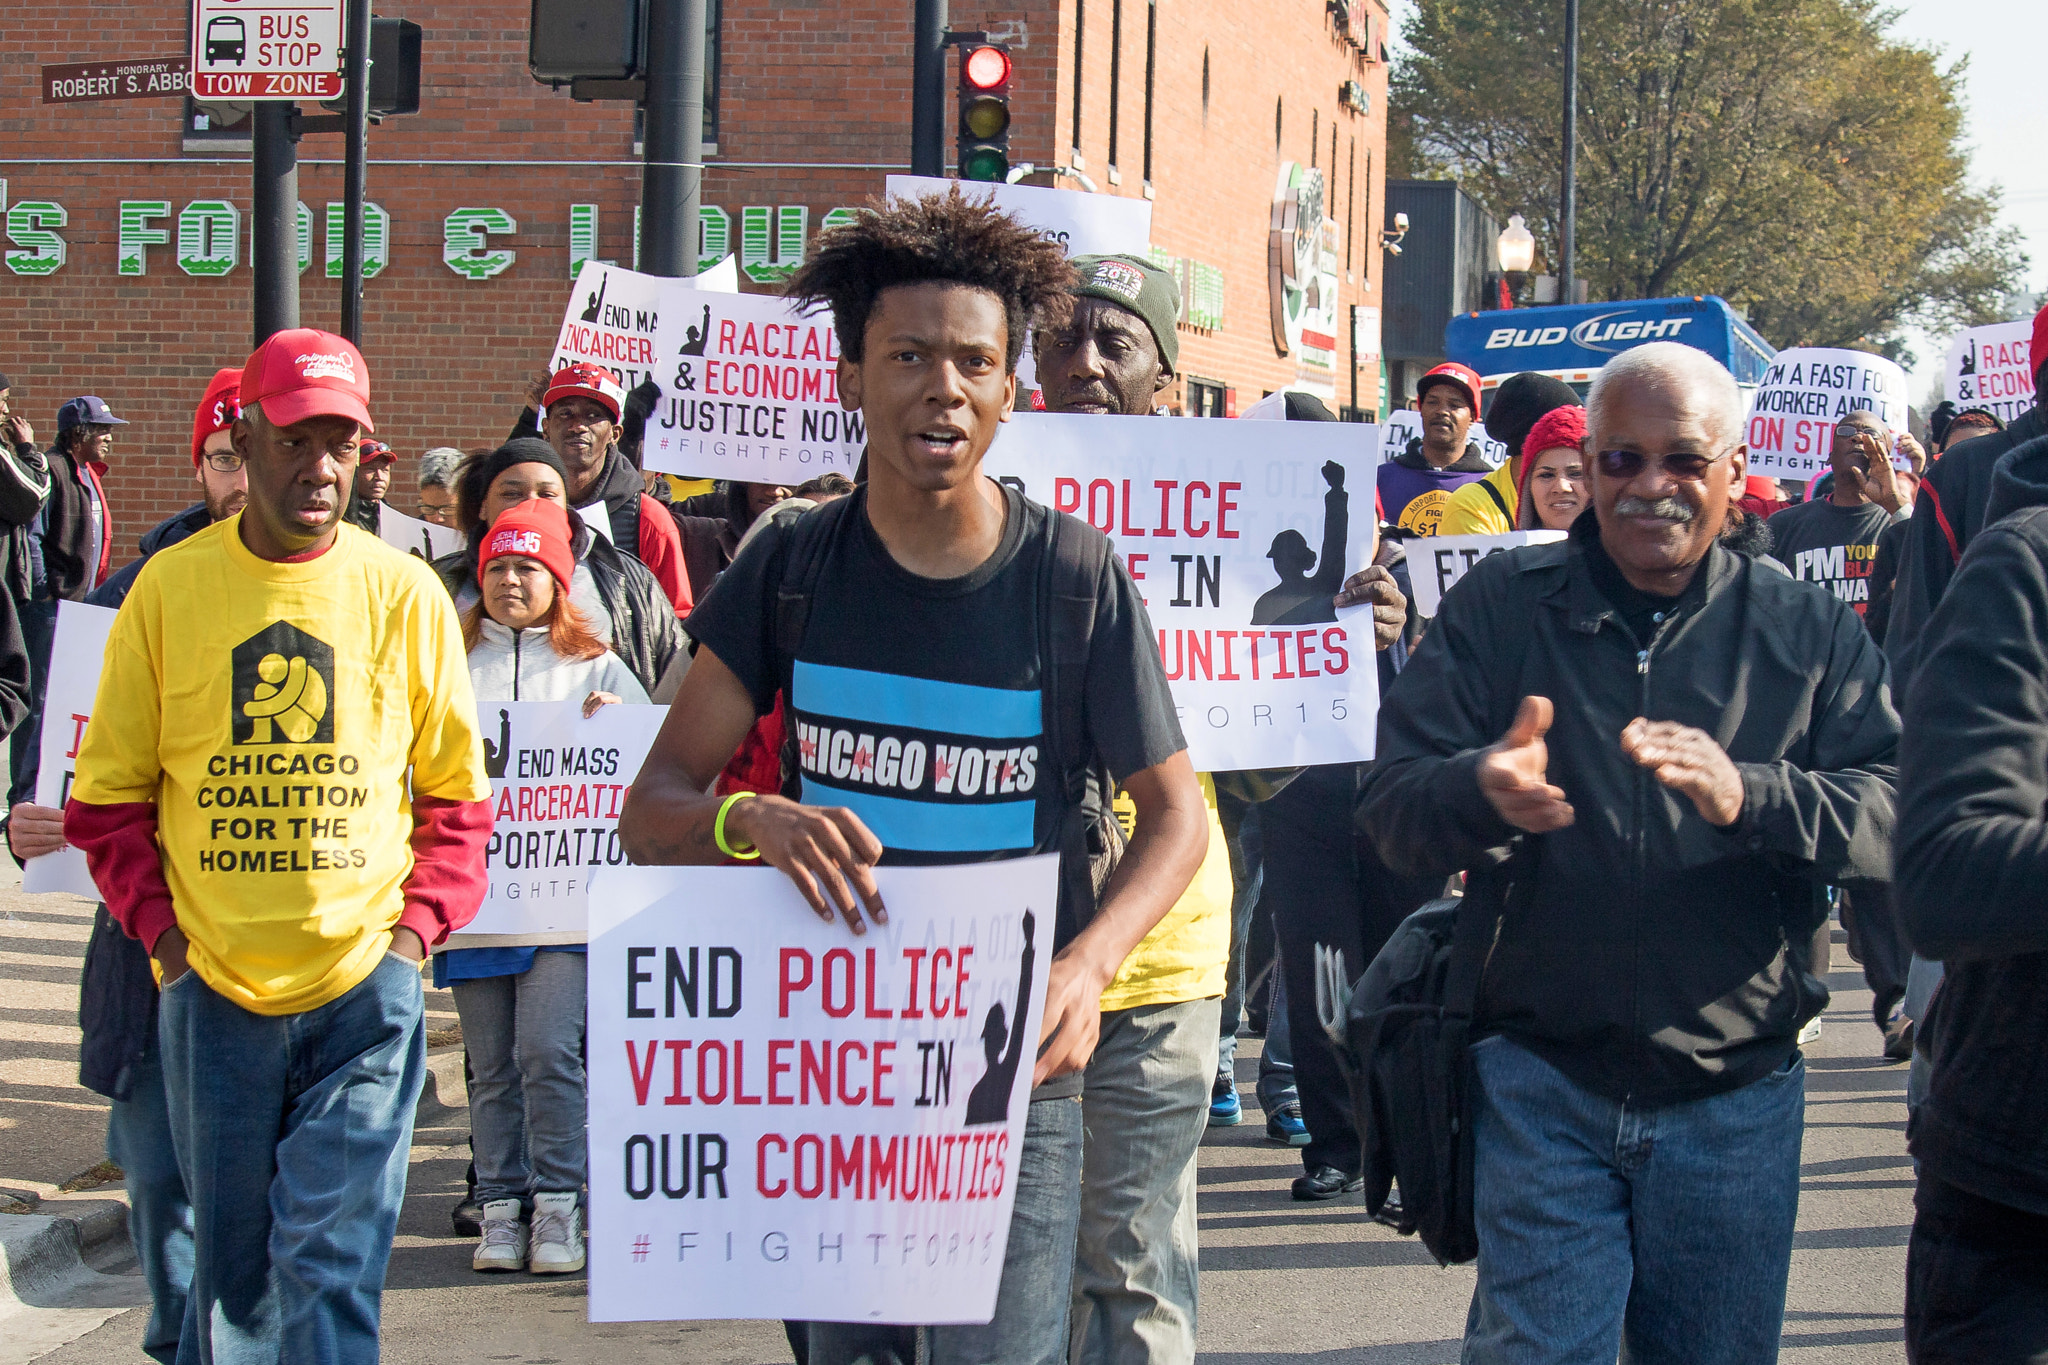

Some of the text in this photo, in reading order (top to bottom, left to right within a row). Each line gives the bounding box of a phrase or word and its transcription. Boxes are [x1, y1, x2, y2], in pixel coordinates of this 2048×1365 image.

[260, 15, 309, 38] BUS
[116, 64, 169, 75] HONORARY
[258, 43, 321, 66] STOP
[52, 76, 120, 98] ROBERT
[126, 75, 141, 93] S.
[203, 75, 328, 94] TOW ZONE
[0, 179, 67, 276] S
[118, 200, 390, 278] FOD
[604, 304, 630, 329] END
[562, 323, 658, 364] INCARCER
[719, 319, 838, 362] RACIAL
[1485, 318, 1692, 349] BUD LIGHT
[674, 360, 839, 404] & ECONOMI
[1760, 363, 1786, 388] I'M
[1789, 363, 1803, 386] A
[1809, 363, 1857, 390] FAST
[1959, 370, 2036, 400] & ECON
[1756, 390, 1829, 418] WORKER
[1834, 395, 1873, 418] AND
[661, 398, 787, 440] JUSTICE
[802, 409, 866, 444] NOW
[1749, 416, 1839, 456] ON ST
[1055, 477, 1242, 539] POLICE
[1409, 493, 1437, 514] AIRPORT
[521, 531, 542, 553] 15
[1795, 545, 1845, 582] I'M
[1170, 554, 1220, 608] IN
[1177, 698, 1348, 730] OR15
[208, 754, 359, 777] CHICAGO
[518, 747, 620, 778] END MASS
[795, 717, 1038, 796] HICAGO VOTES
[197, 785, 368, 809] COALITION
[490, 783, 631, 822] ARCERATI
[211, 818, 348, 840] FOR THE
[200, 849, 366, 873] HOMELESS
[485, 828, 632, 869] PORTATIO
[490, 879, 589, 900] IGHTF
[626, 946, 974, 1019] END POLICE
[625, 1039, 954, 1107] VIOLENCE IN
[624, 1133, 1009, 1202] OUR COMMUNITIES
[631, 1230, 995, 1267] #FIGHTFOR15
